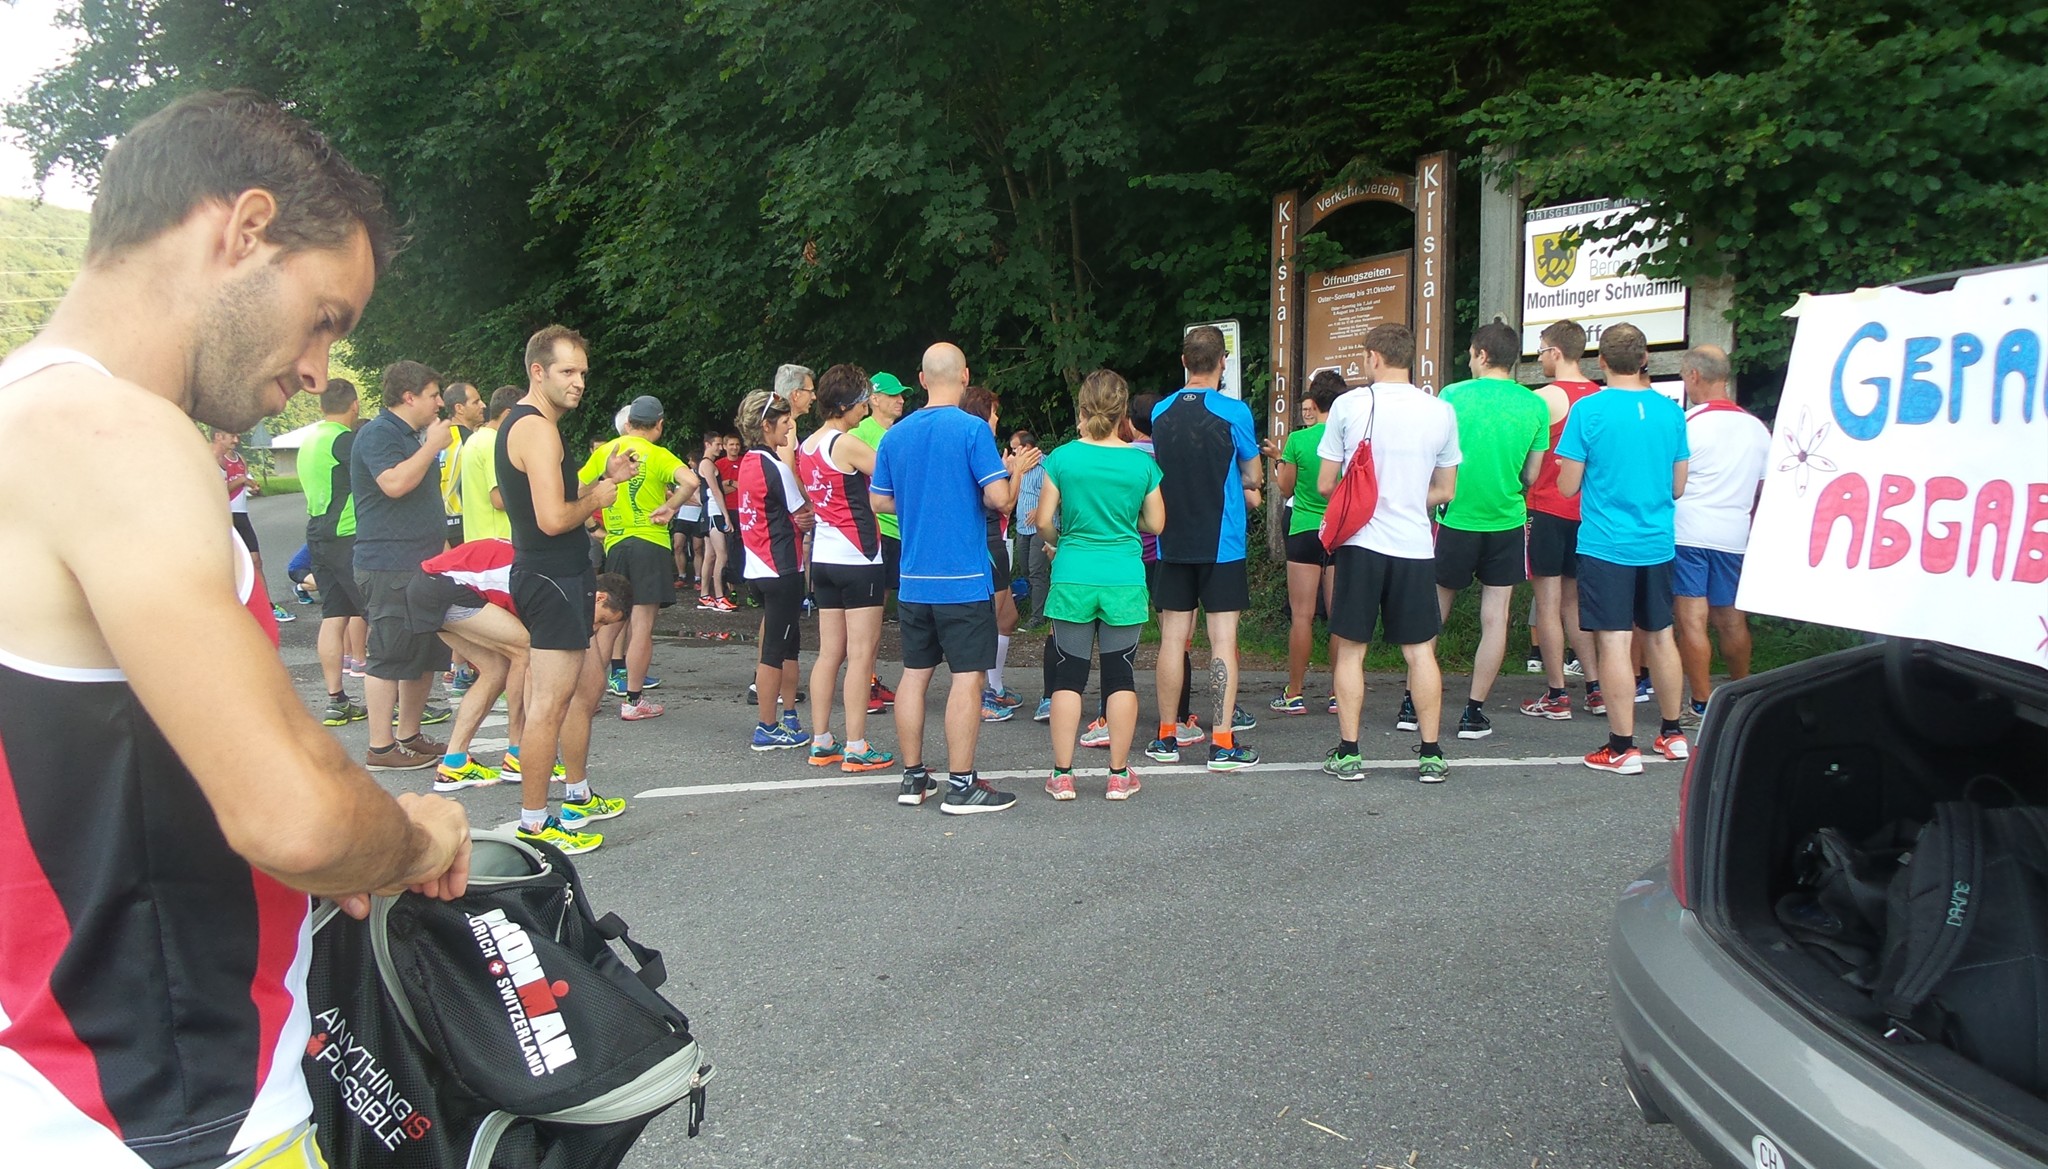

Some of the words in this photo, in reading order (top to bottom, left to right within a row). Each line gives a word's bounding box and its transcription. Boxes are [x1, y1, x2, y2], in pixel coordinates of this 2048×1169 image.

[1528, 200, 1609, 221] ORTSGEMEINDE
[1317, 291, 1356, 304] Oster-Sonntag
[1356, 289, 1365, 297] bis
[1366, 284, 1396, 295] 31.Oktober
[1322, 267, 1391, 287] Öffnungszeiten
[1526, 288, 1601, 310] Montlinger
[1605, 280, 1683, 301] Schwamm
[1274, 200, 1291, 477] Kristallhöhl
[1830, 293, 2048, 441] GEPÄ
[465, 912, 498, 959] URICH
[496, 977, 546, 1078] SWITZERLAND
[316, 1007, 413, 1121] ANYTHING
[316, 1042, 407, 1152] POSSIBLE
[1760, 1142, 1777, 1169] CH
